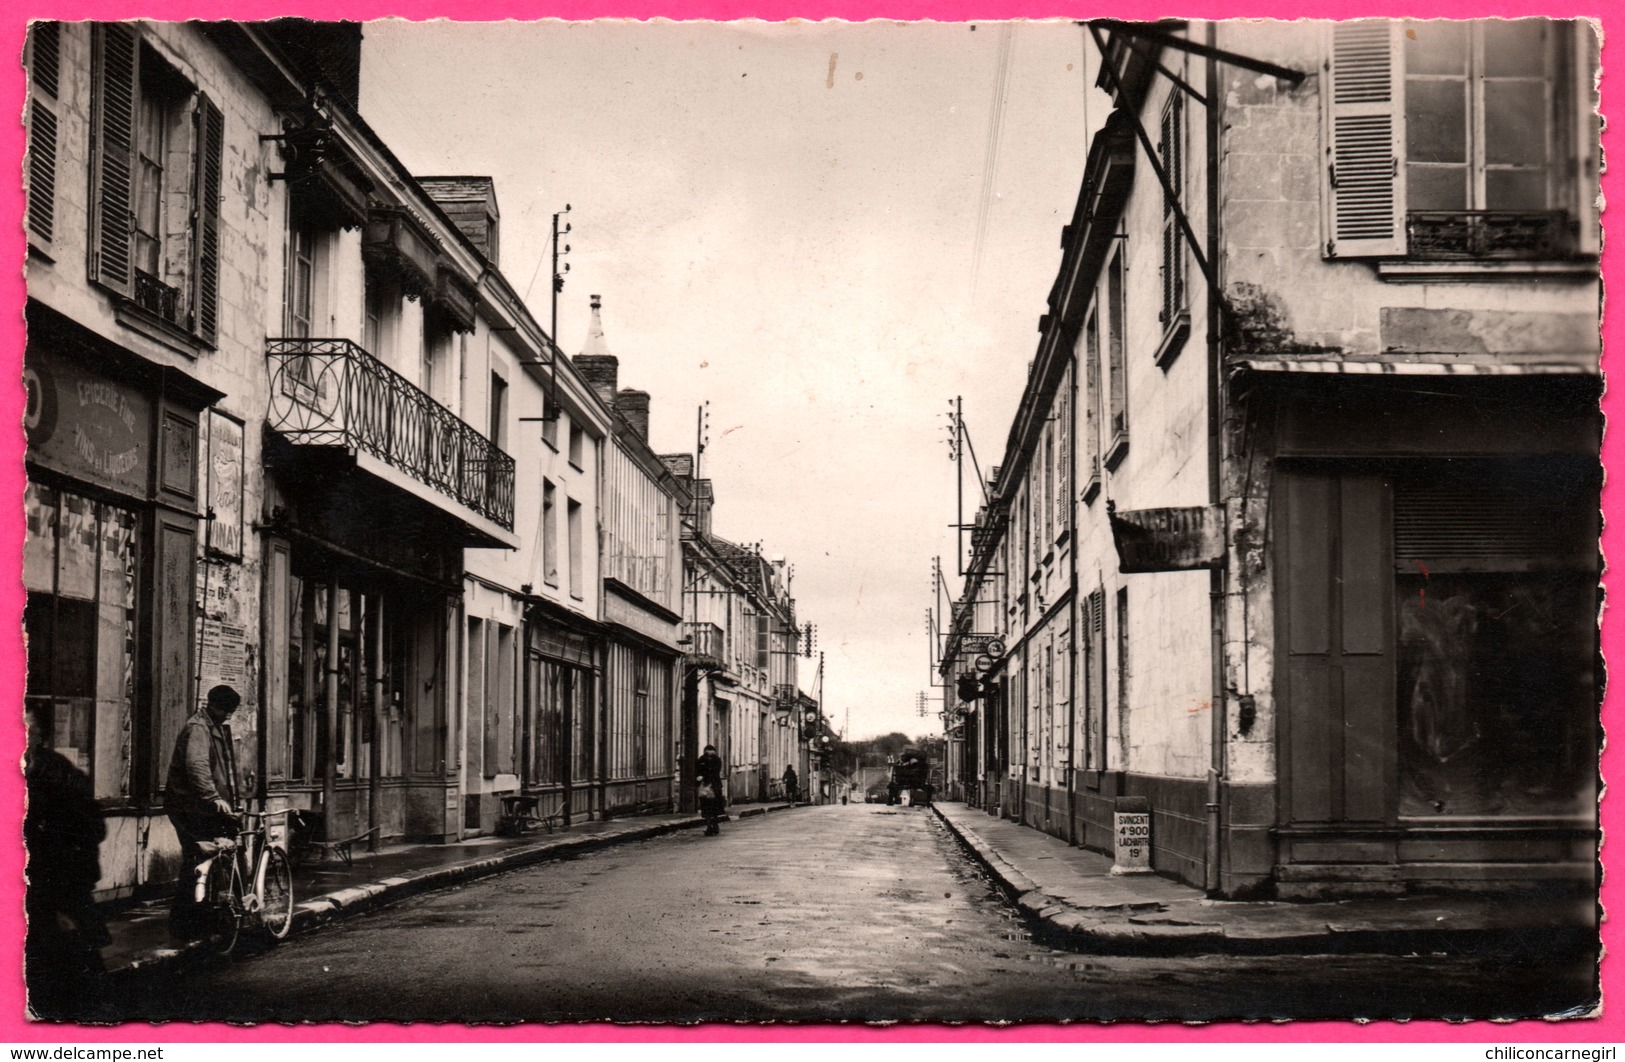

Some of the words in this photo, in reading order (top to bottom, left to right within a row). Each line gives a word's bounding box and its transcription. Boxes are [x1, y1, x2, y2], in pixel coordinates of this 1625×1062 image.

[118, 393, 137, 434] FINE
[74, 422, 95, 464] VINS
[962, 636, 993, 645] GARAGE
